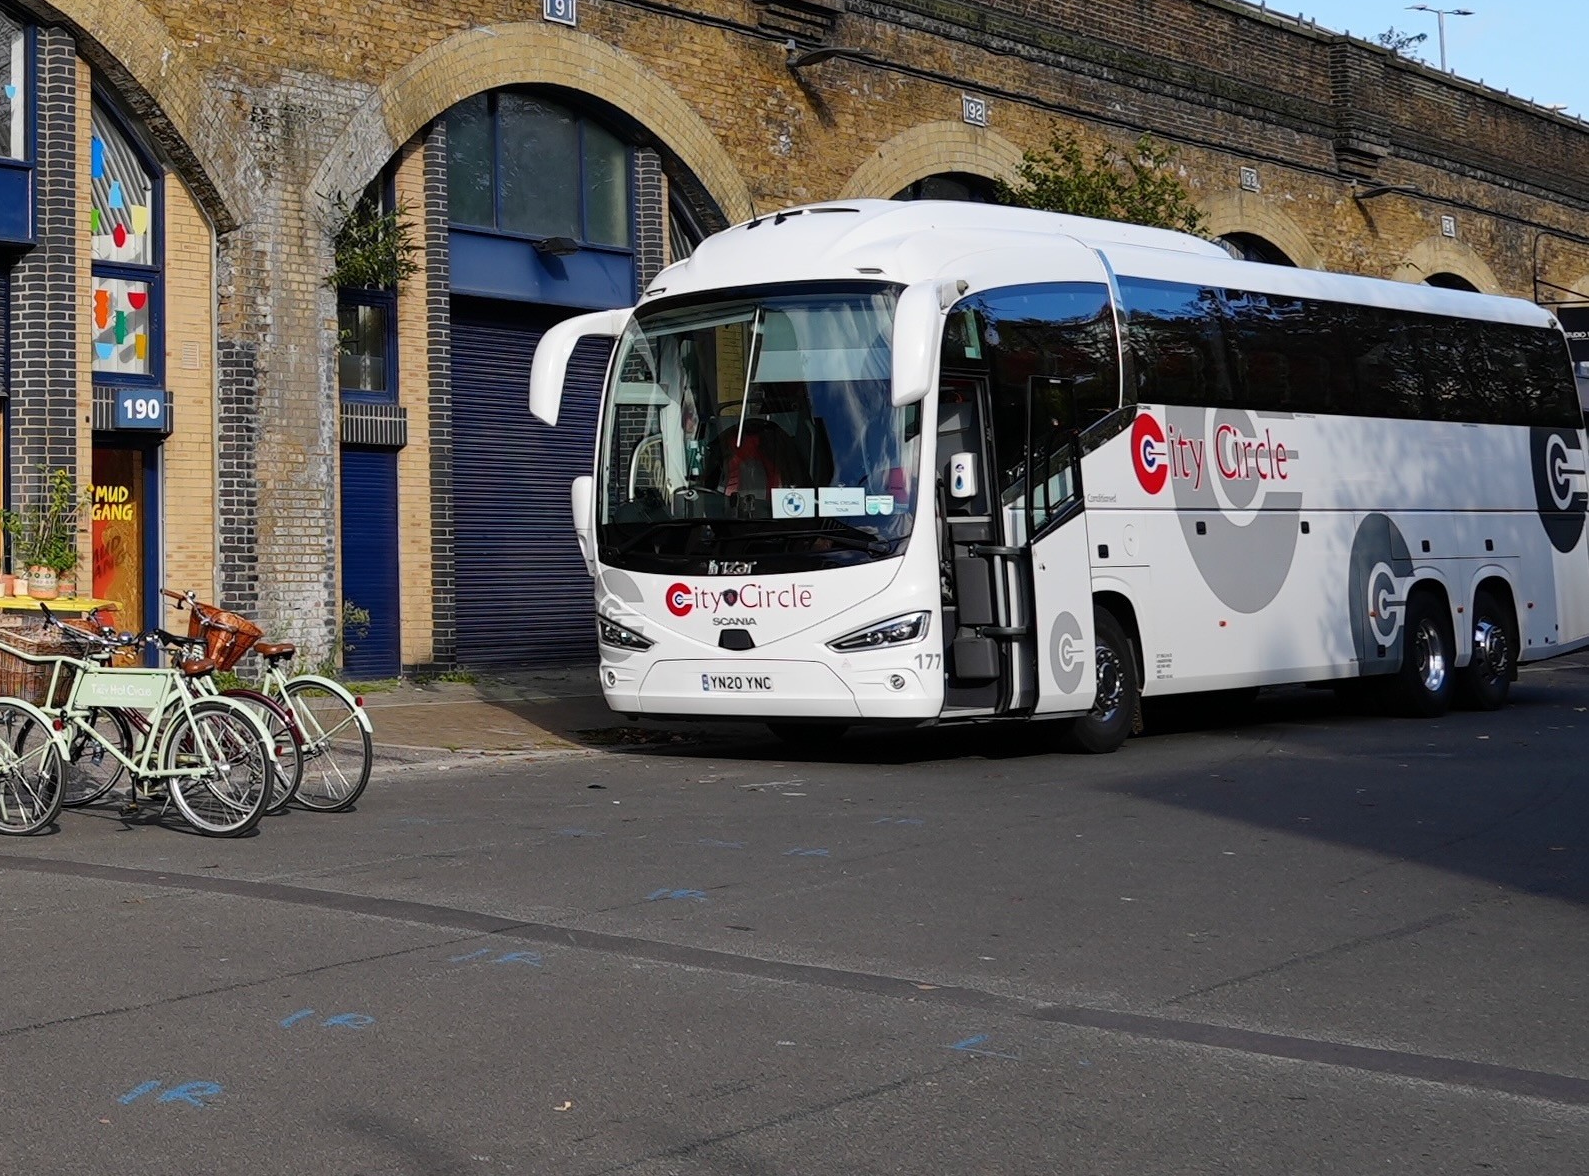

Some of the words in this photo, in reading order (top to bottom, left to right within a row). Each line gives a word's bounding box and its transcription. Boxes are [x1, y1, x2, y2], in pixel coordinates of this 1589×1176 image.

[965, 102, 983, 121] 192
[123, 398, 160, 419] 190
[1130, 413, 1205, 495] City
[1214, 423, 1289, 481] Circle
[95, 485, 129, 503] MUD
[92, 503, 134, 522] GANG
[666, 582, 722, 617] City
[739, 583, 813, 609] Circle
[713, 617, 758, 626] SCANIA
[914, 653, 941, 670] 177
[710, 676, 743, 690] YN20
[745, 676, 772, 690] YNC
